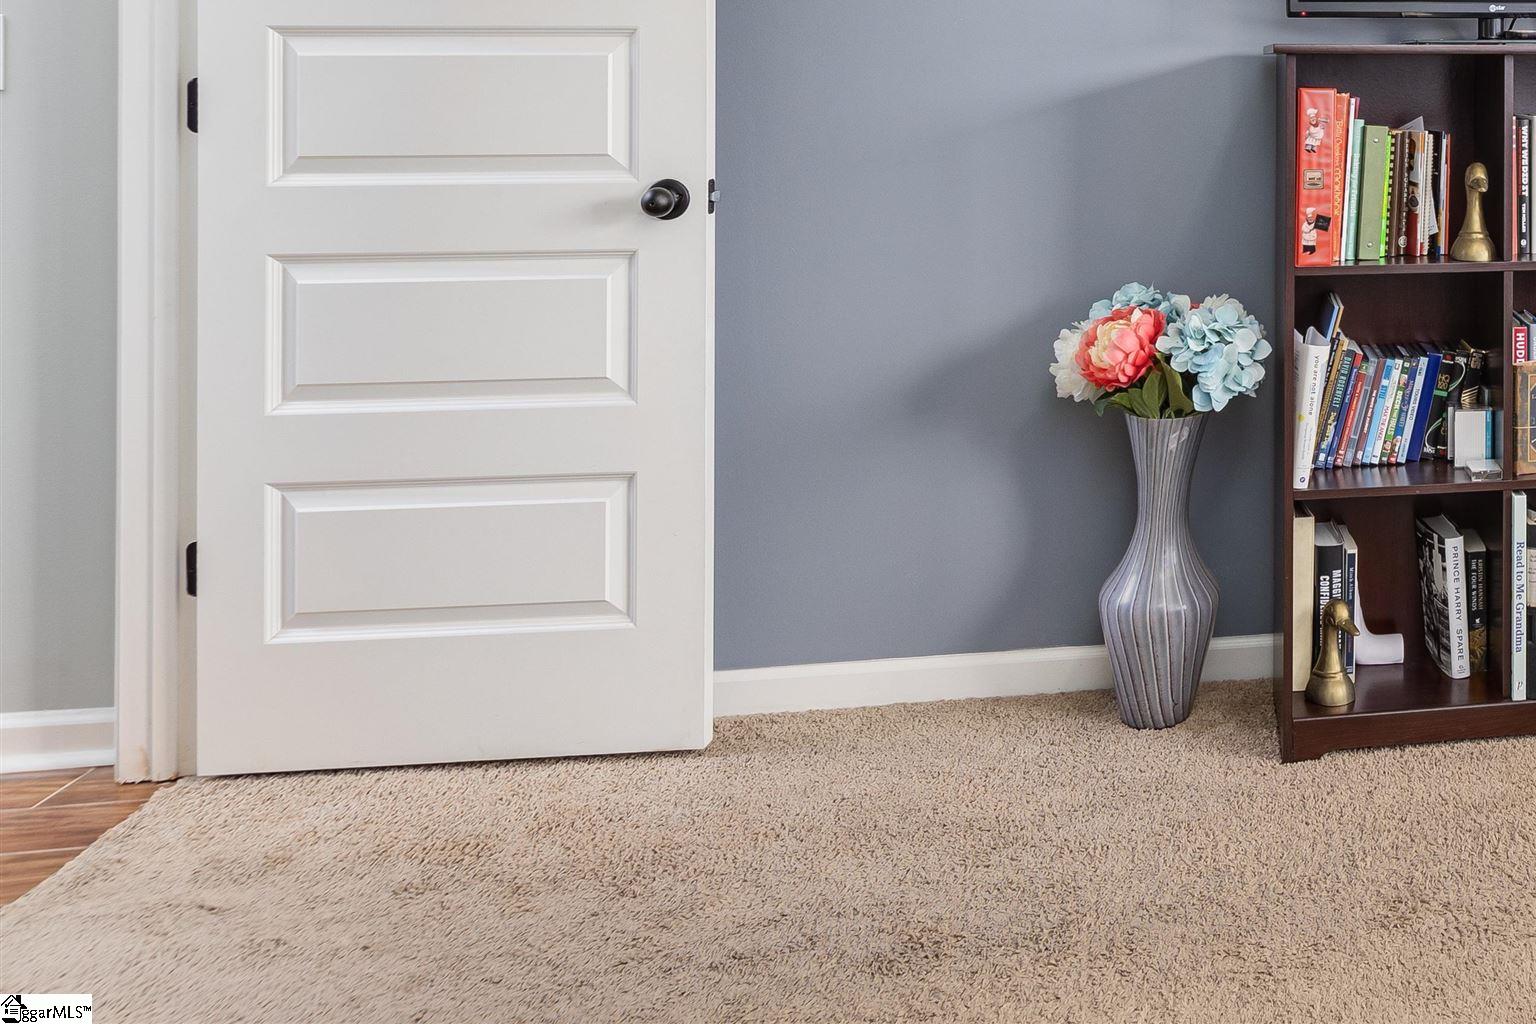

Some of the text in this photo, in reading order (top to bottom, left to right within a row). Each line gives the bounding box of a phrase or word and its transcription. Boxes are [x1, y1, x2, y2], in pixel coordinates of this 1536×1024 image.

[1313, 355, 1321, 368] you
[1340, 356, 1352, 374] DAVID
[1331, 375, 1347, 409] ROSENFELT
[1393, 390, 1403, 410] DECK
[1308, 396, 1316, 416] alone
[1408, 406, 1416, 422] VIDEO
[1387, 418, 1398, 436] HALLS
[1451, 545, 1464, 661] PRINCE HARRY SPARE
[1515, 541, 1525, 653] Read to Me Grandma
